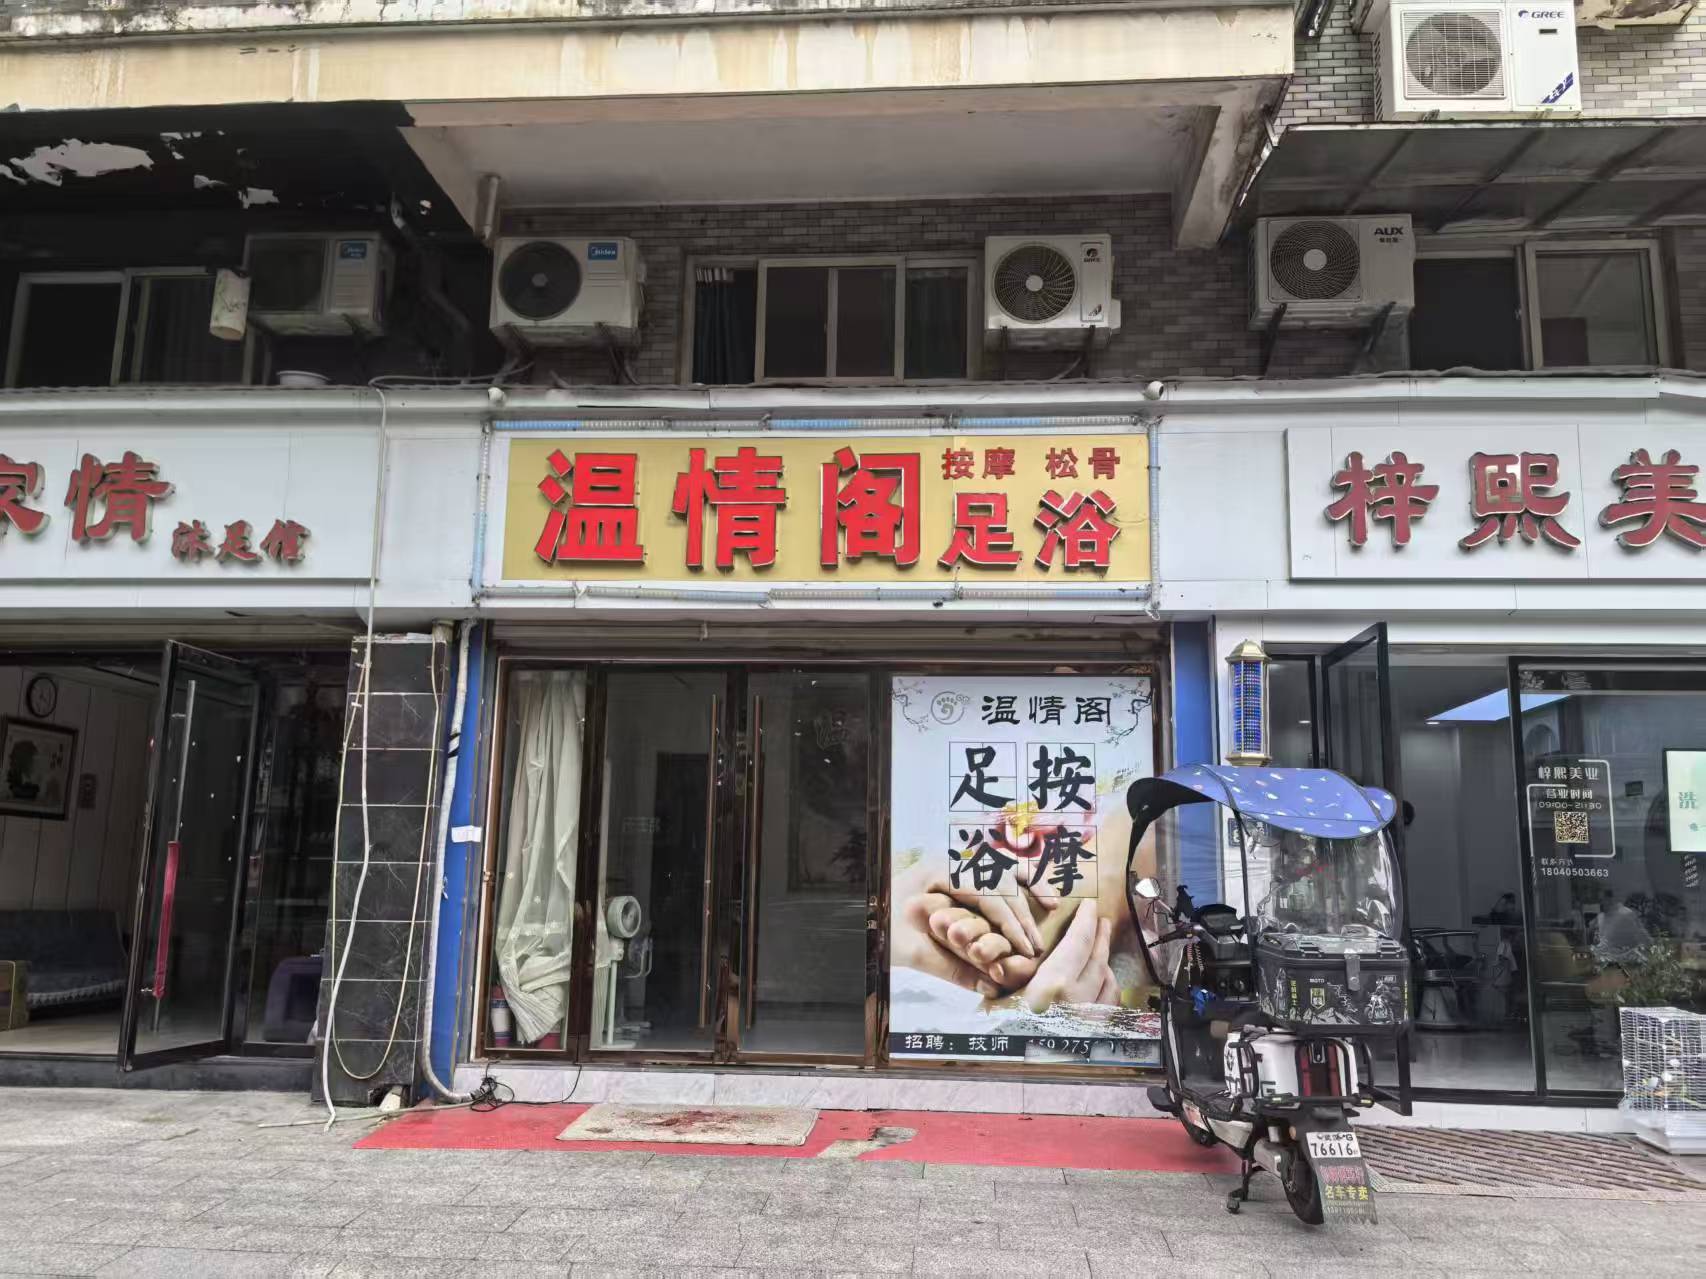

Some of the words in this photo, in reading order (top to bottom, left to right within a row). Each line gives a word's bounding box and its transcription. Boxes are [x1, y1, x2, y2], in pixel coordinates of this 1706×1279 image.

[1531, 11, 1565, 19] GREE
[1374, 226, 1404, 236] AUX
[942, 447, 1016, 478] 按摩
[1045, 446, 1122, 479] 松骨
[534, 446, 922, 569] 温情阁
[1325, 448, 1706, 551] 梓熙美
[937, 490, 1121, 571] 足浴
[981, 695, 1112, 726] 温情阁
[1541, 867, 1609, 878] 18040503663
[969, 1036, 1009, 1052] 技师
[1310, 1142, 1354, 1157] 76616
